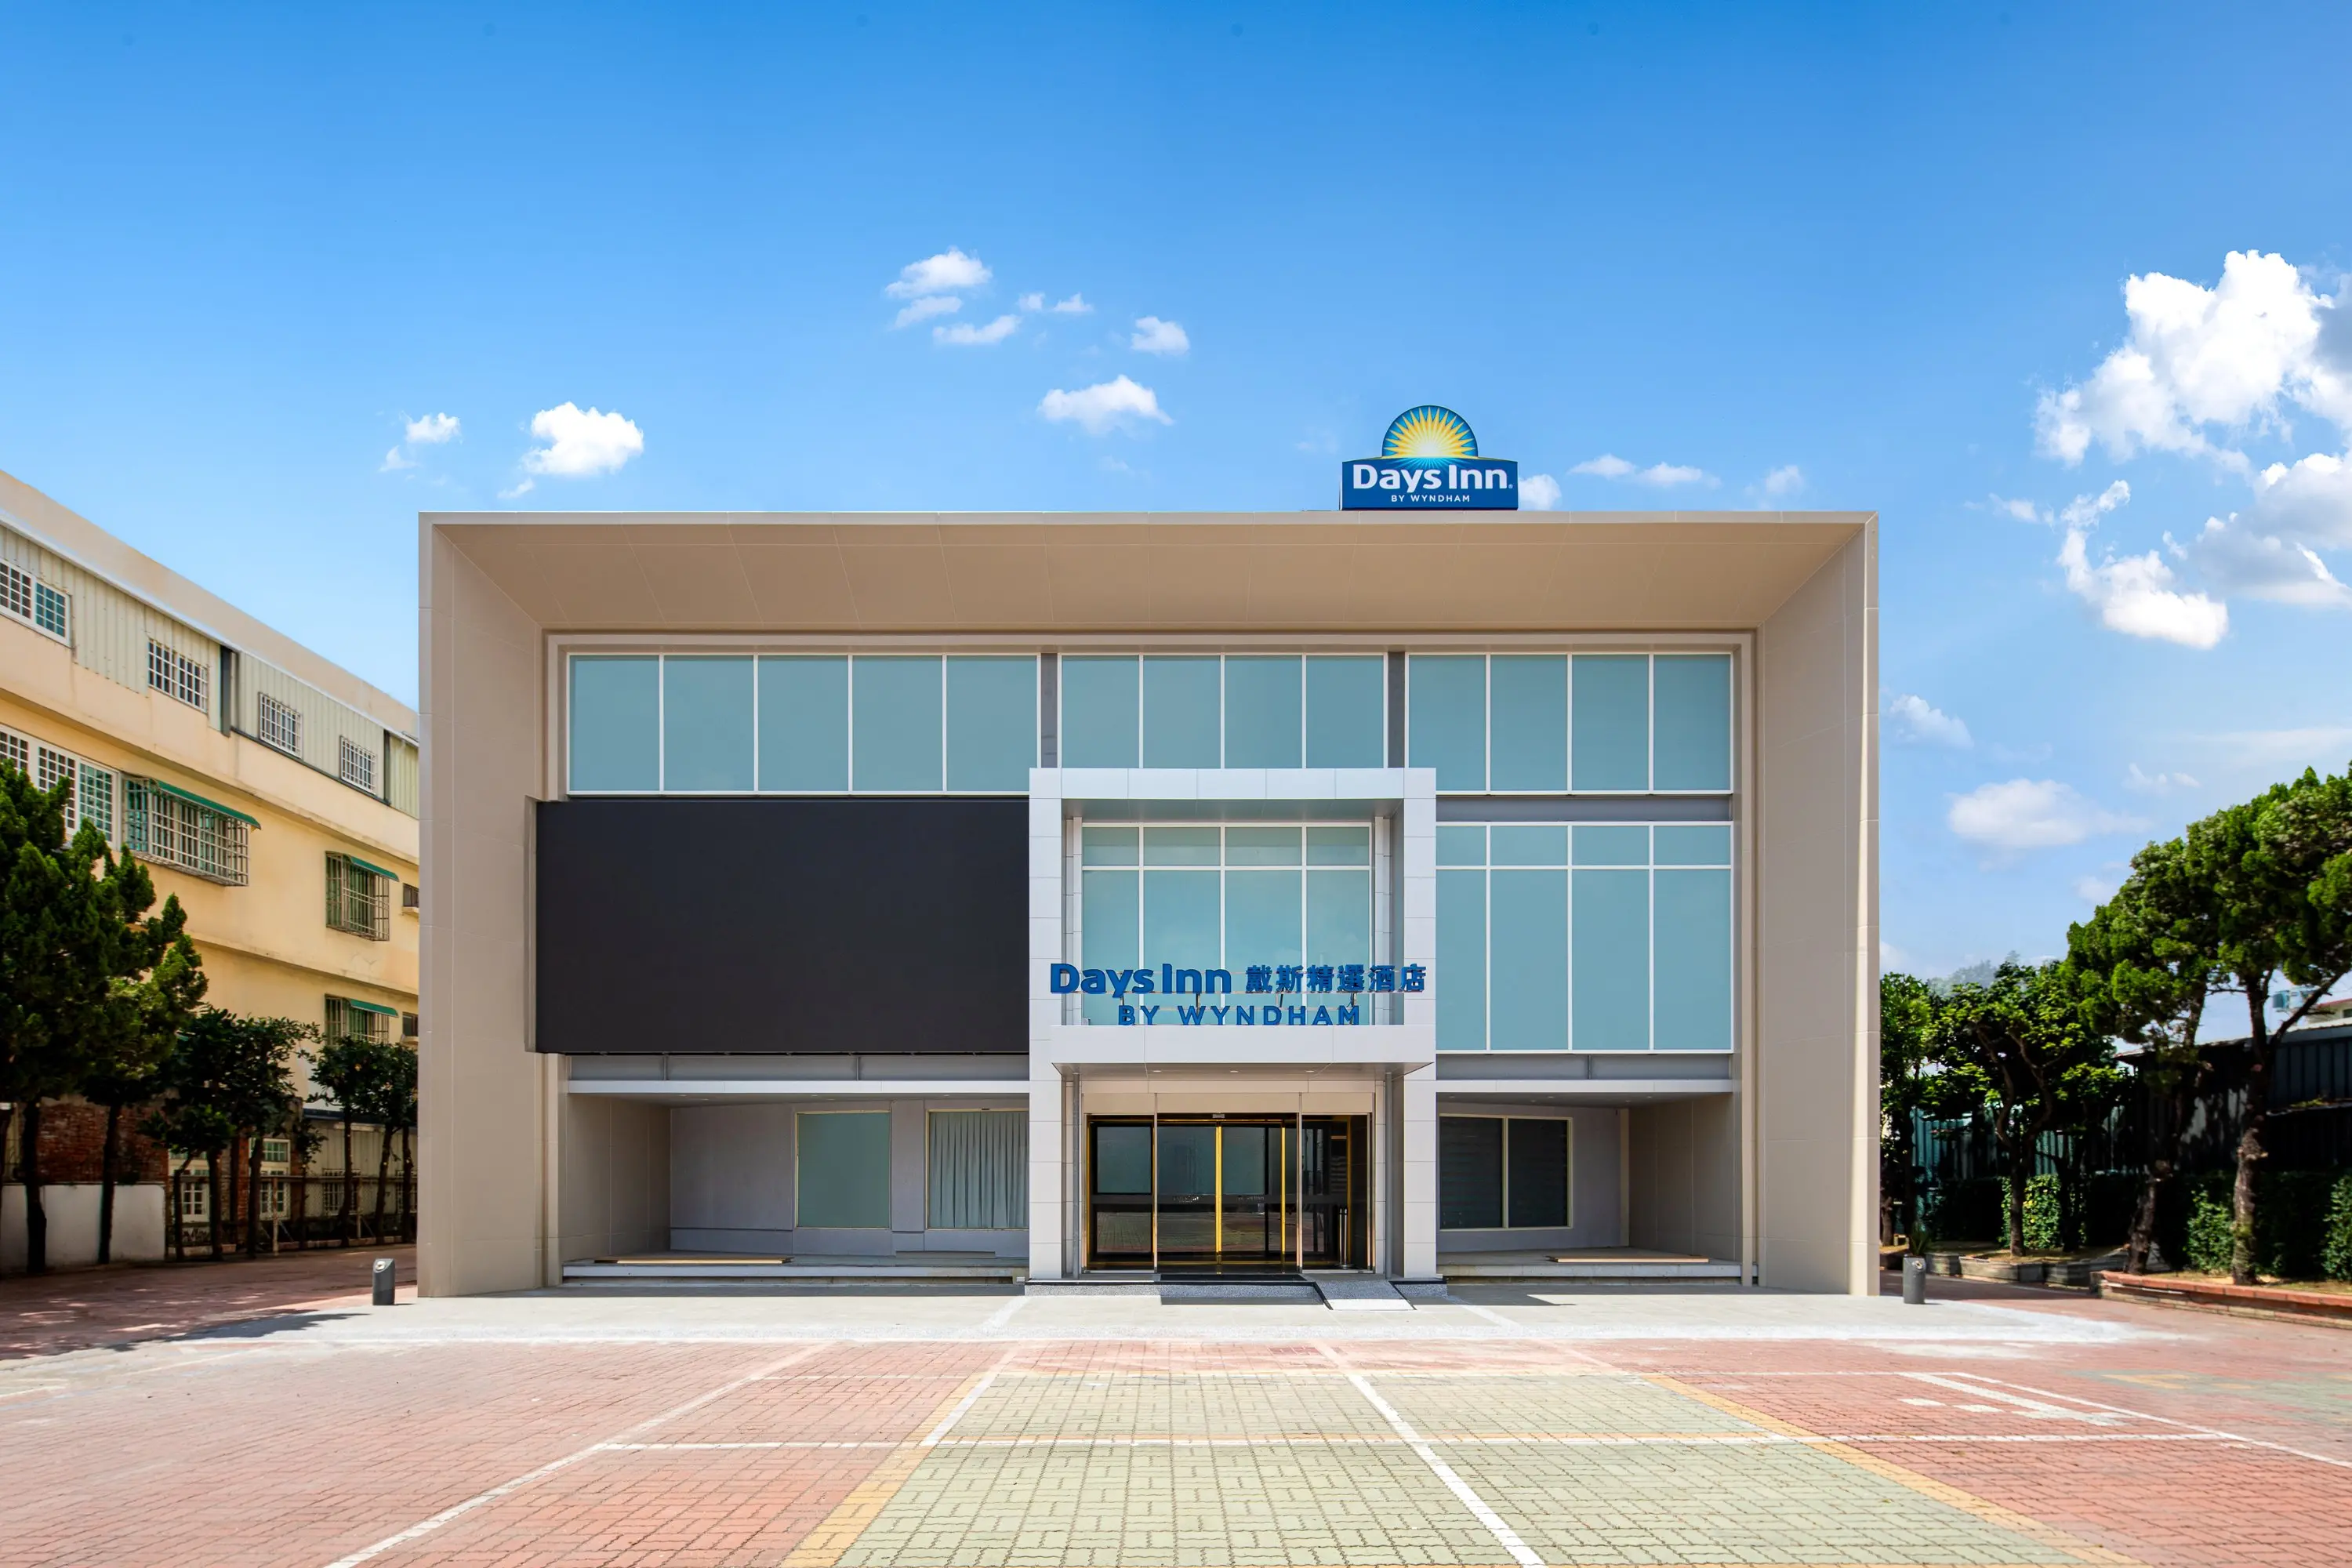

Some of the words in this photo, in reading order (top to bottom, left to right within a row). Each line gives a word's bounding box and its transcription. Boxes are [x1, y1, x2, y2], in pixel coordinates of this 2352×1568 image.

[1353, 464, 1442, 493] Days
[1448, 464, 1508, 489] Inn
[1051, 963, 1155, 998] Days
[1162, 963, 1232, 994] Inn
[1245, 963, 1427, 993] 戴斯精選酒店
[1118, 1005, 1160, 1025] BY
[1178, 1005, 1359, 1025] WYNDHAM
